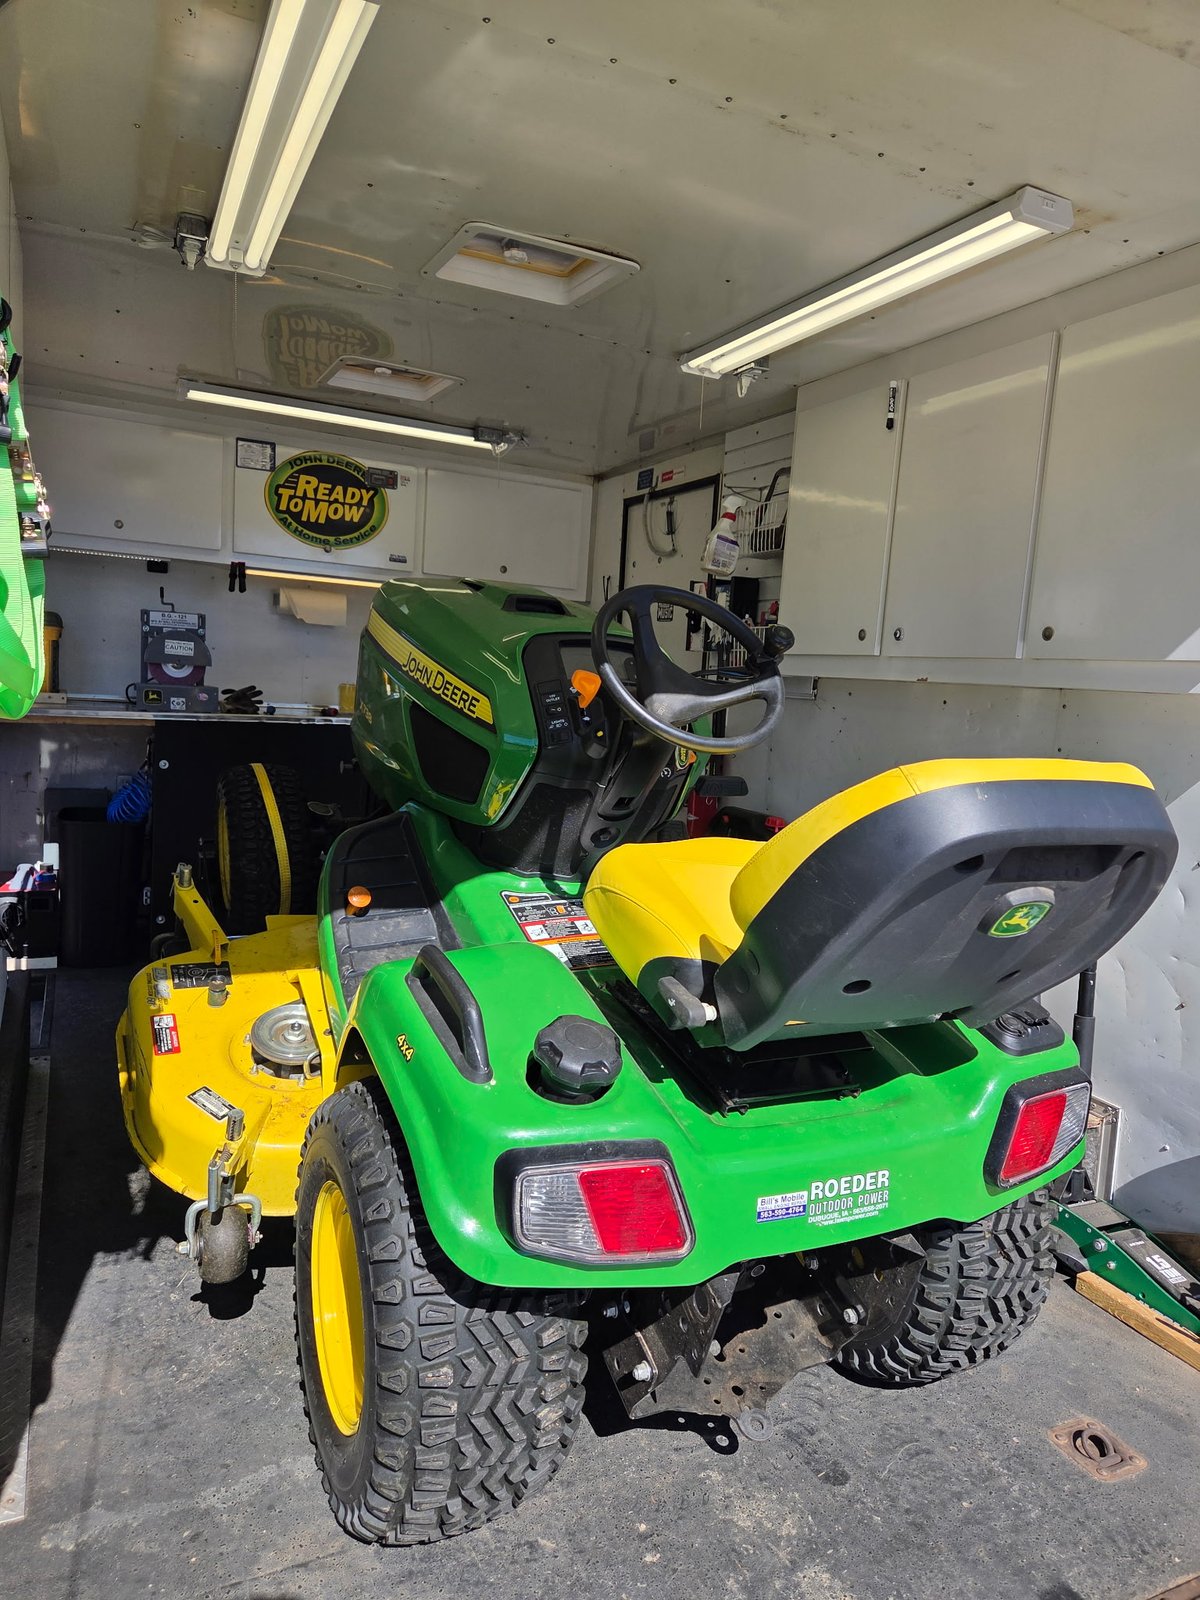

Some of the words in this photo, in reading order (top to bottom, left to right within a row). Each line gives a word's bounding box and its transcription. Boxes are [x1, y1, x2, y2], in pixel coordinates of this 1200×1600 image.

[288, 455, 323, 470] JOHN
[295, 474, 376, 506] READY
[279, 516, 292, 530] At
[293, 524, 331, 546] Home
[333, 524, 377, 546] Service
[165, 644, 193, 652] CAUTION
[402, 652, 433, 687] JOHN
[432, 670, 480, 715] DEERE
[760, 1197, 779, 1206] Bill's
[780, 1193, 805, 1203] Mobile
[810, 1170, 890, 1201] ROEDER
[809, 1197, 853, 1216] OUTDOOR
[858, 1190, 889, 1207] POWER
